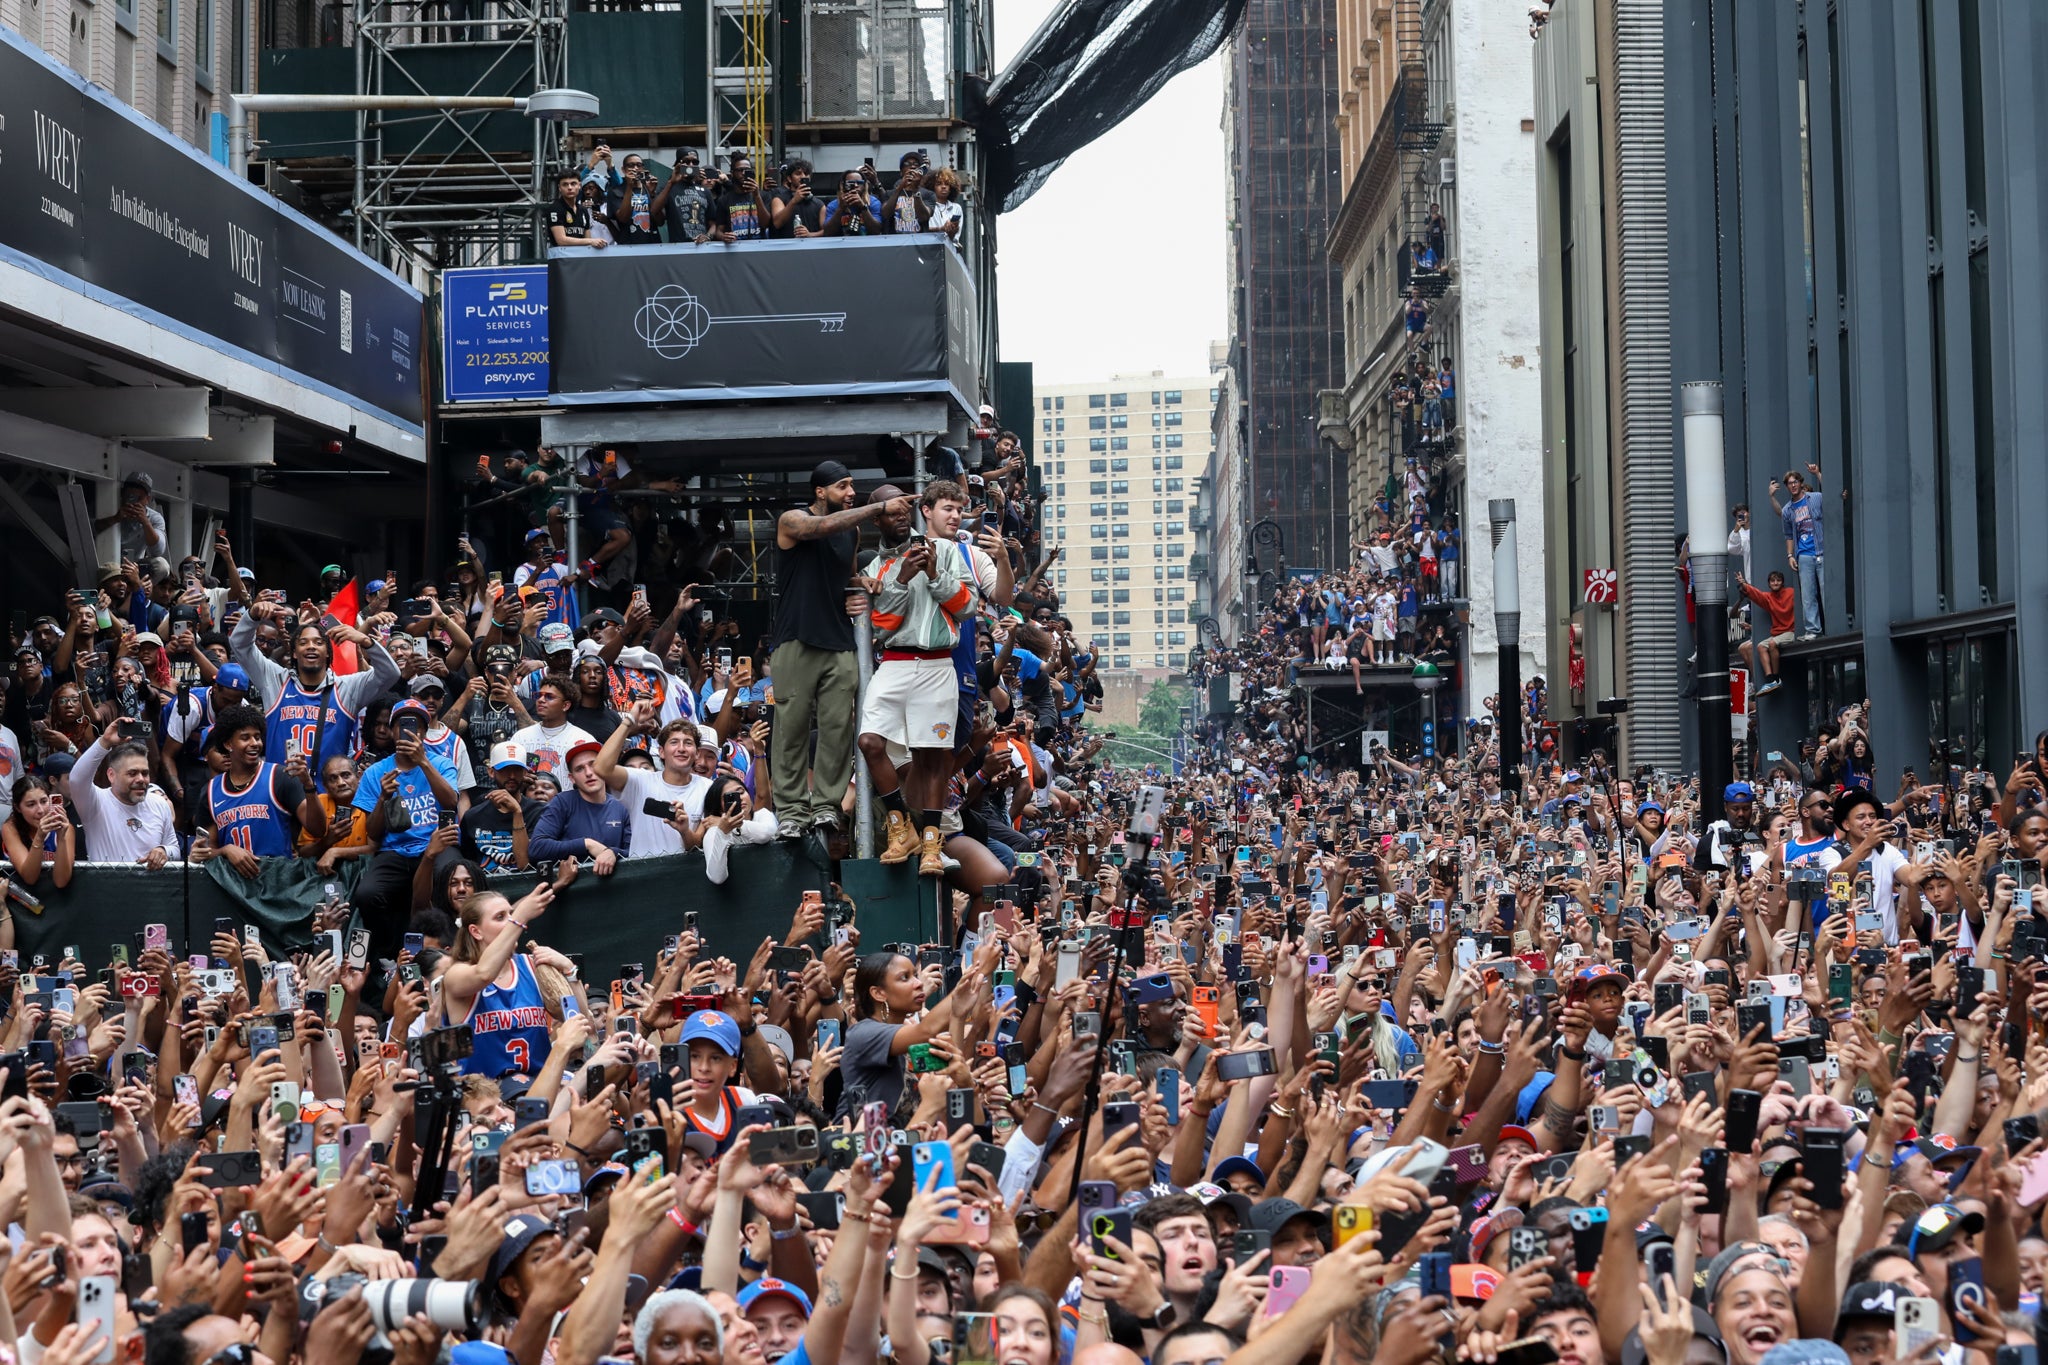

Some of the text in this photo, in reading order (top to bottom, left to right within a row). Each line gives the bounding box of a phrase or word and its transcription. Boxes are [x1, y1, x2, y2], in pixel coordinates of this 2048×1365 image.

[34, 109, 81, 194] WREY
[41, 196, 51, 215] 222
[109, 185, 209, 260] An Invitation to the Exceptional
[228, 221, 263, 288] WREY
[283, 280, 326, 321] NOW LEASING
[486, 321, 532, 331] SERVICES
[820, 320, 844, 332] 222
[487, 337, 509, 345] Sidewalk
[484, 372, 536, 385] psny.nyc
[280, 705, 337, 723] NEW YOK
[216, 803, 270, 831] NEW YORK
[230, 825, 253, 855] 11
[1836, 884, 1846, 894] R
[474, 1006, 548, 1035] NEW YORK
[505, 1037, 530, 1076] 3
